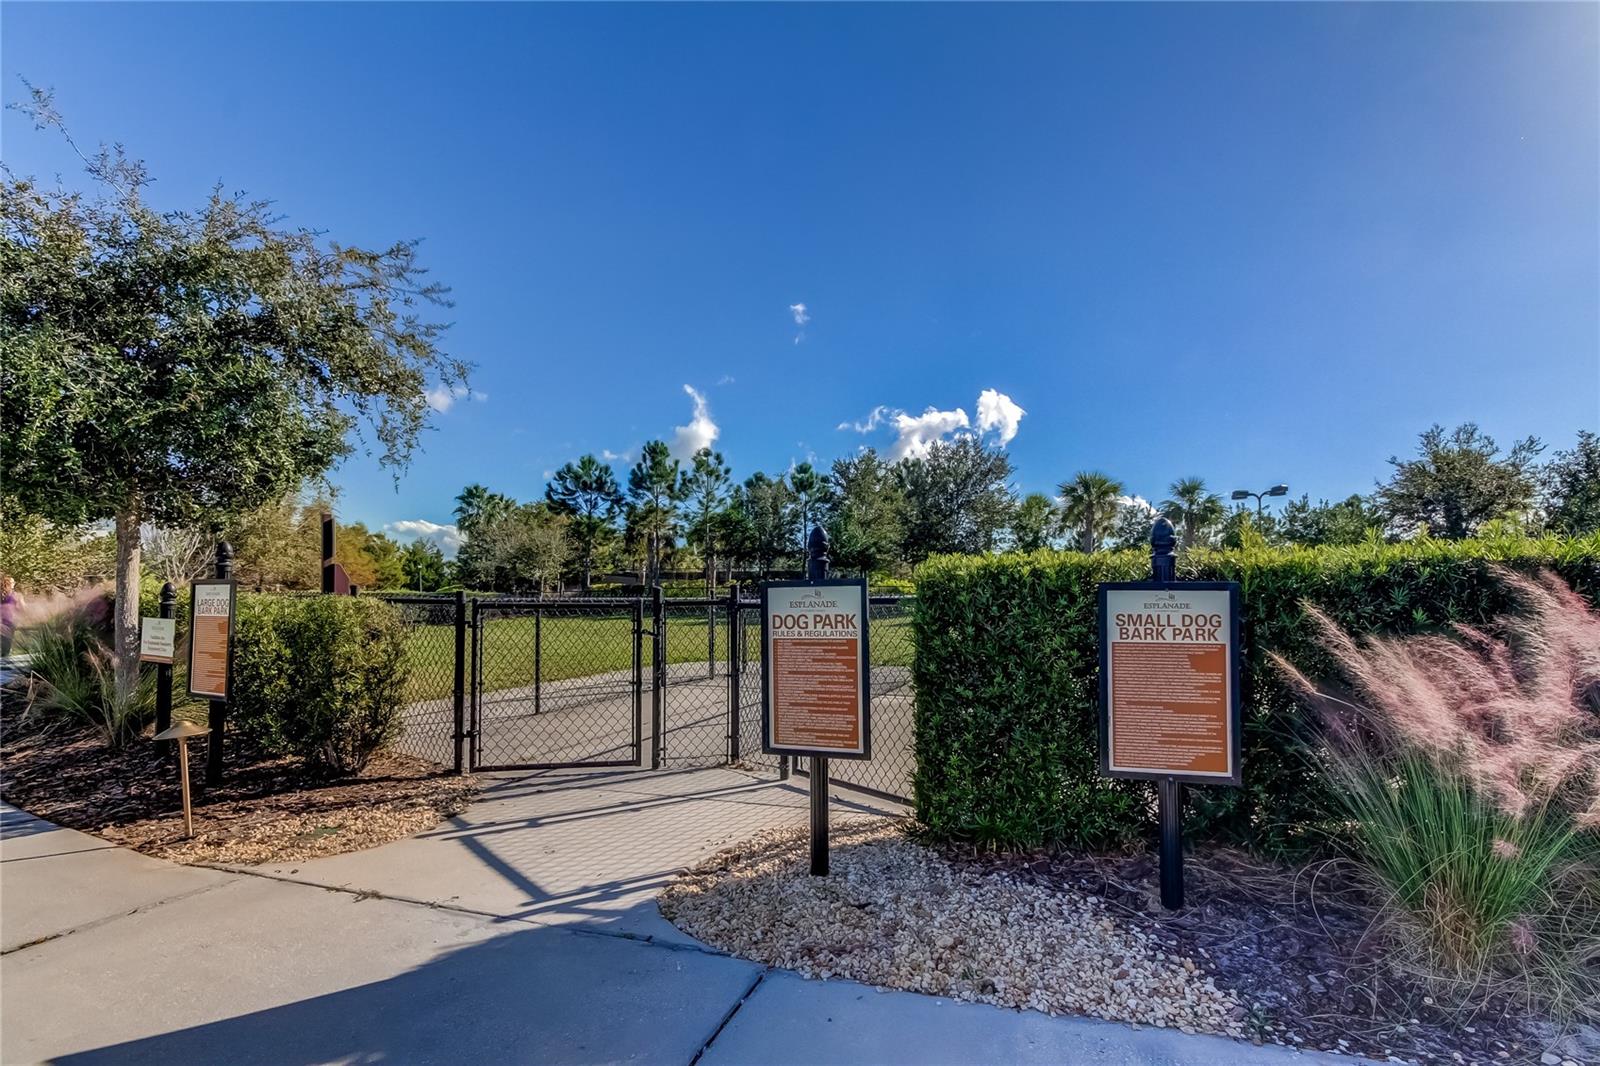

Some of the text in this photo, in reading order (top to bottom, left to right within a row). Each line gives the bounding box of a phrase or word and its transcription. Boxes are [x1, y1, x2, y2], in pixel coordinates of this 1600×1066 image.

[197, 598, 229, 607] LARGE DOG
[789, 600, 838, 609] ESPLANADE
[1143, 602, 1192, 610] ESPLANADE
[197, 606, 228, 615] BARK PARK
[772, 613, 858, 630] DOG PARK
[1115, 613, 1222, 628] SMALL DOG
[772, 630, 858, 638] RULES & REGULATIONS
[1119, 627, 1220, 642] BARK PARK
